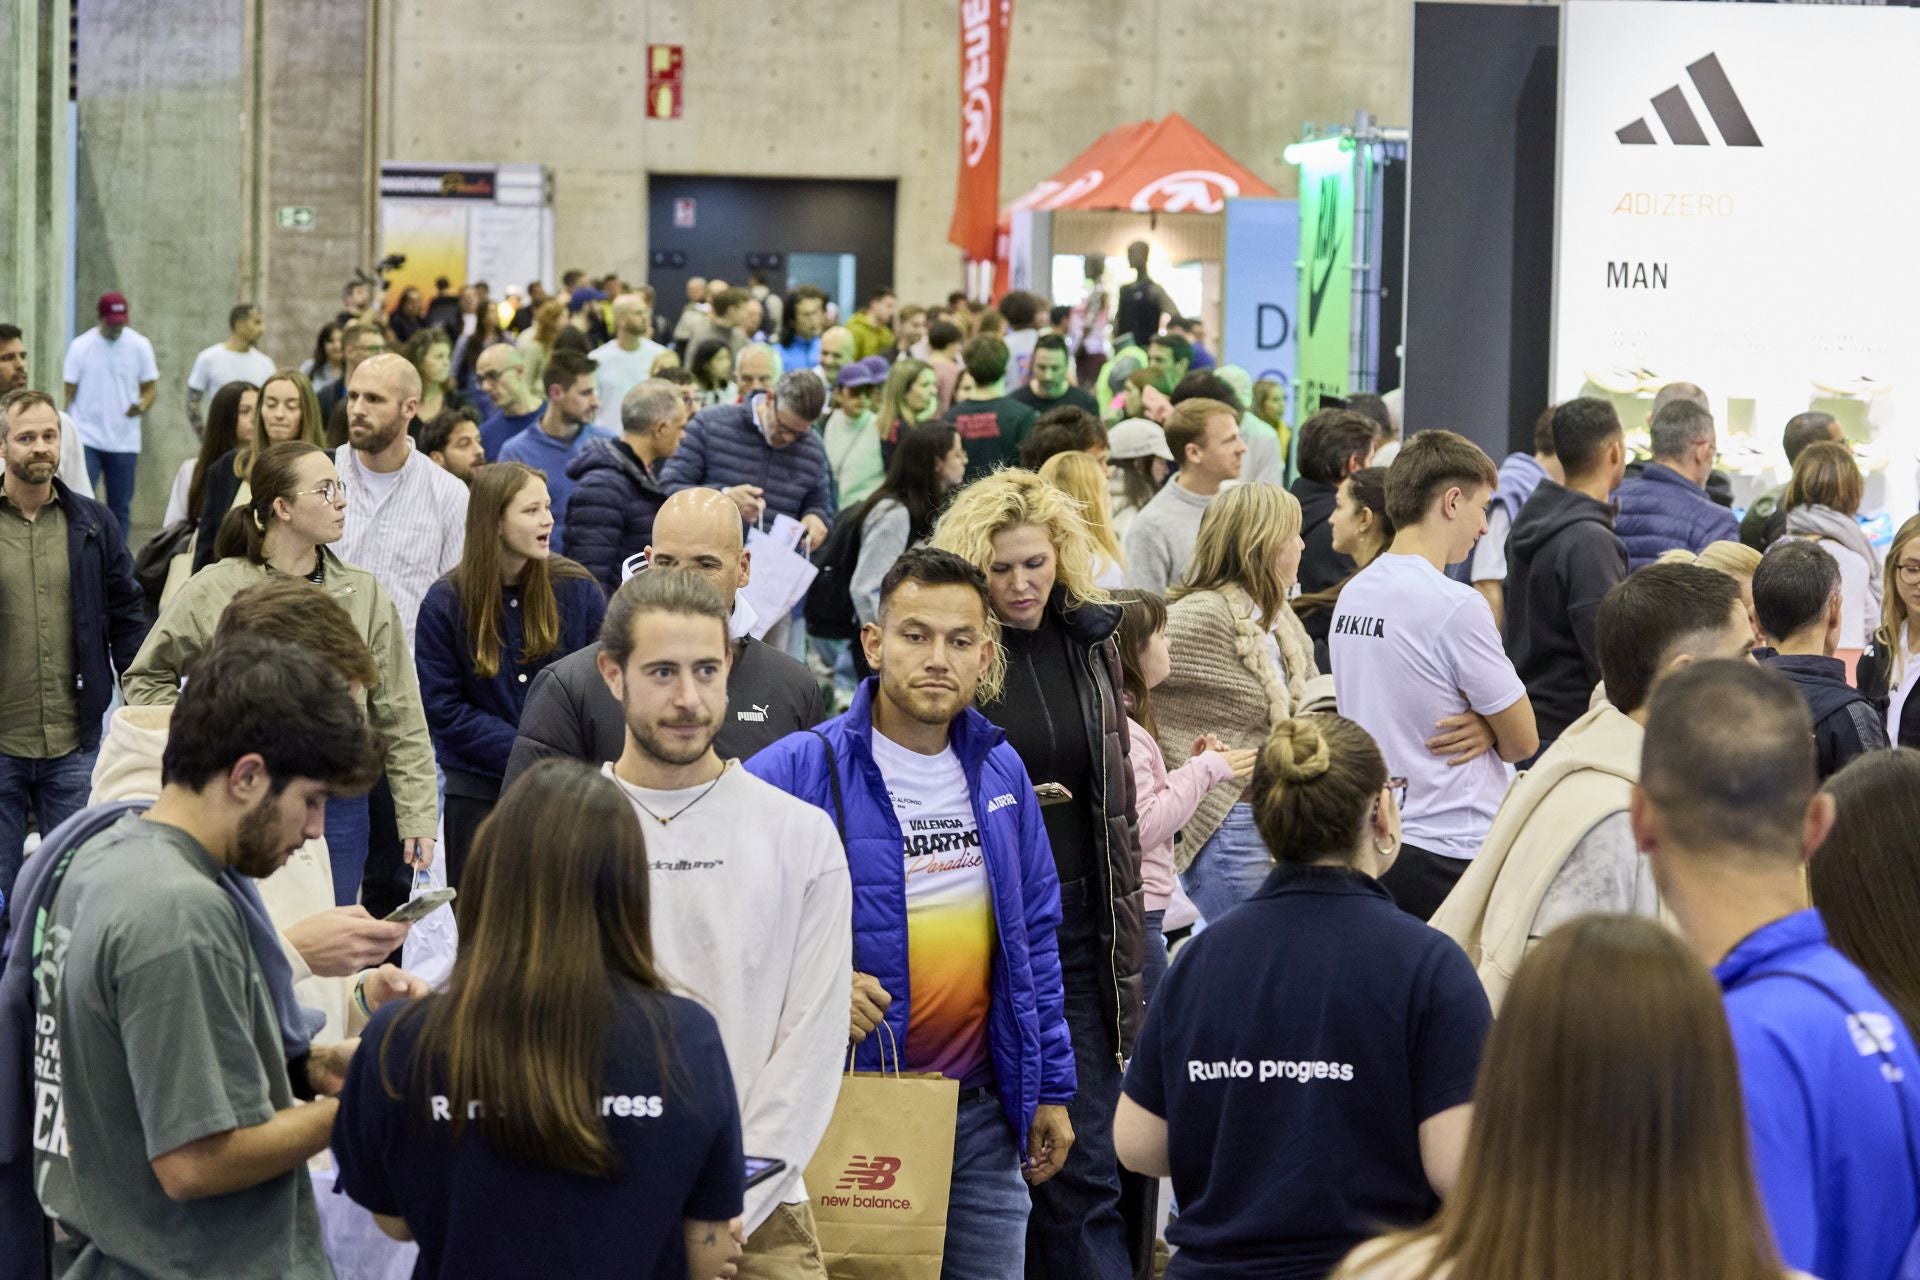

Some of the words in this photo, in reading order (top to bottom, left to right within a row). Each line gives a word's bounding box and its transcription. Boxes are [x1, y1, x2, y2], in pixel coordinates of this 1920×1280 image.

[1611, 191, 1734, 217] ADIZERO
[1606, 260, 1668, 289] MAN
[1335, 615, 1385, 638] BIKILA
[909, 818, 964, 831] VALENCIA
[906, 848, 982, 883] Paradise
[1259, 1060, 1354, 1084] progress
[821, 1194, 851, 1207] new
